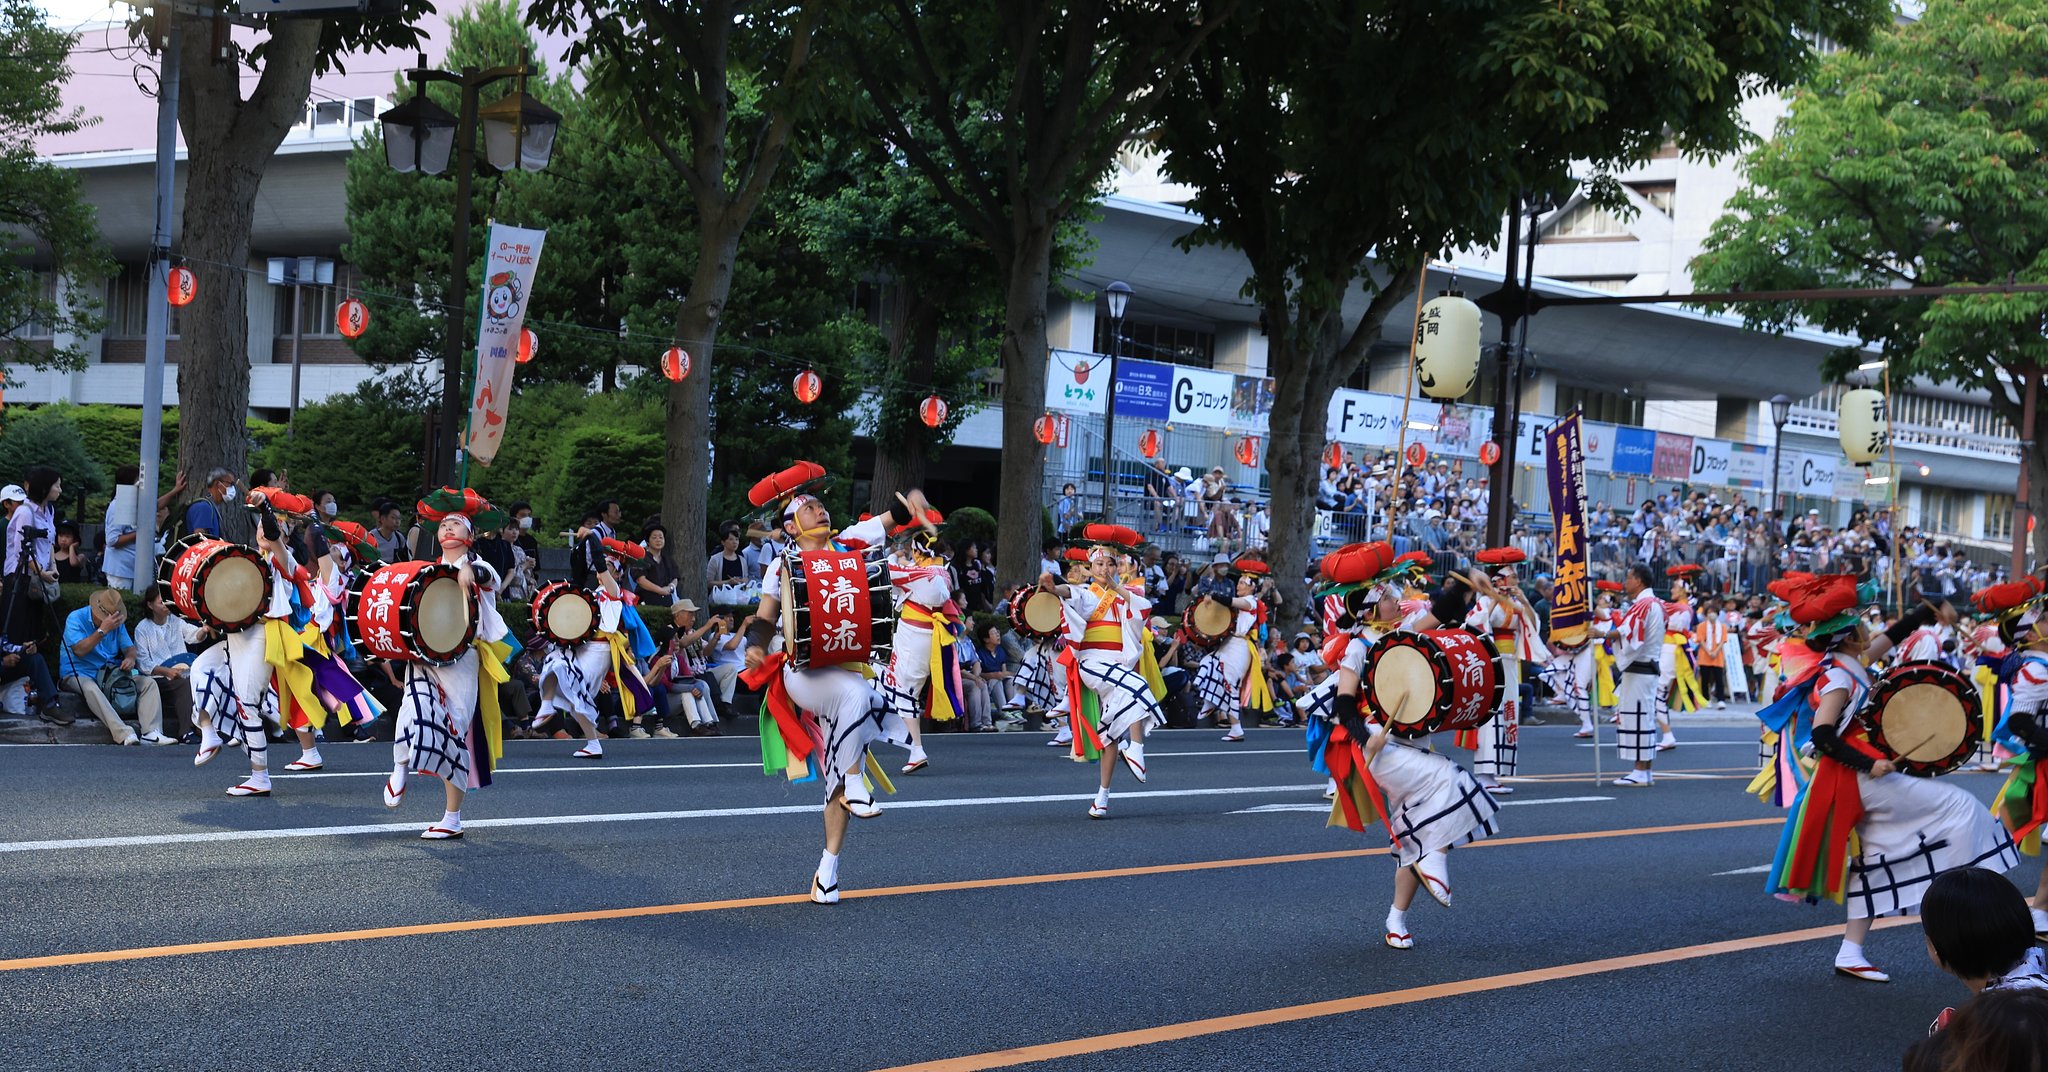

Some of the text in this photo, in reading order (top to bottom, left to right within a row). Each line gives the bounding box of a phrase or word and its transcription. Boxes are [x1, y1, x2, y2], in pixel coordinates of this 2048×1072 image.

[1427, 306, 1441, 335] 盛岡
[1175, 377, 1193, 414] G
[1196, 391, 1228, 410] ブロック
[1340, 399, 1356, 433] F
[1359, 412, 1388, 430] ブロック
[1531, 424, 1544, 456] E
[1692, 445, 1705, 474] D
[1707, 456, 1729, 471] ブロック
[1802, 459, 1814, 487] C
[1814, 469, 1834, 483] ブロック
[1322, 515, 1330, 531] G
[372, 571, 410, 586] 盛岡
[811, 557, 859, 574] 盛岡
[366, 588, 403, 653] 清流
[819, 576, 862, 653] 清流
[1436, 634, 1475, 649] 盛岡
[1451, 650, 1486, 724] 清流
